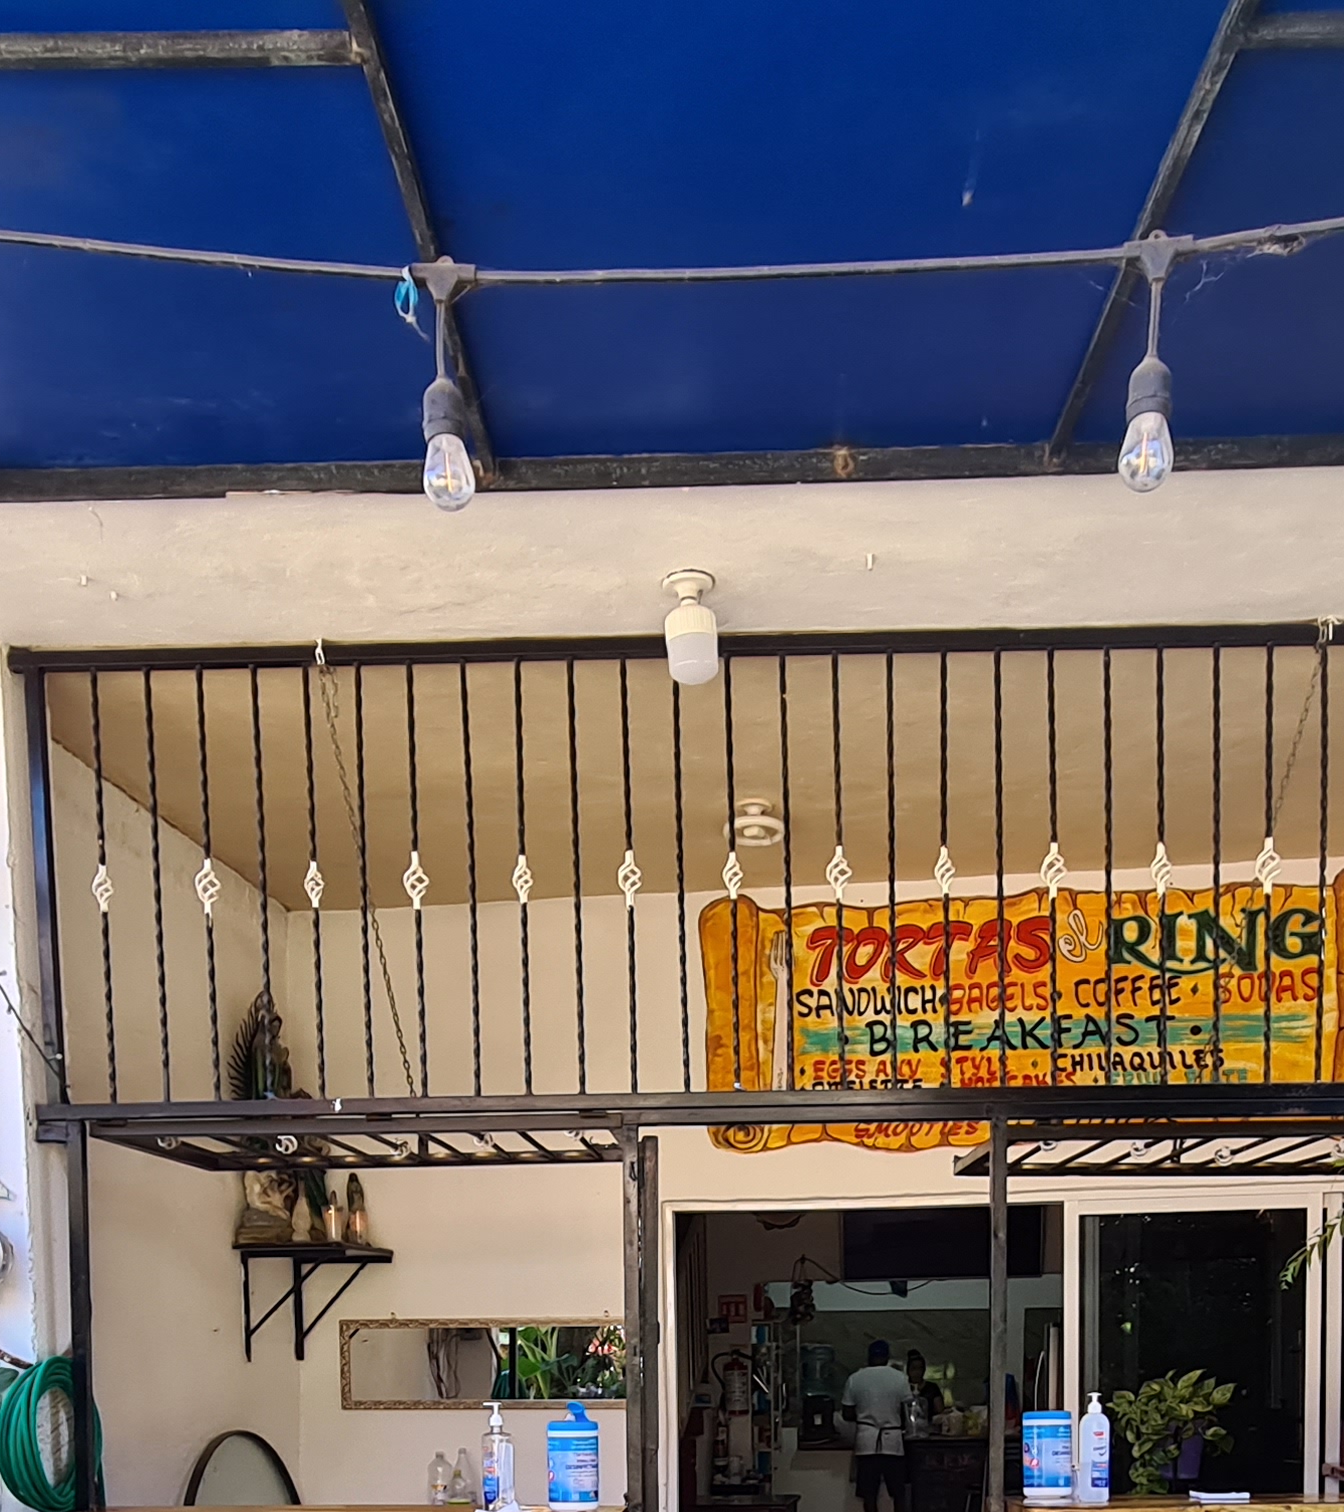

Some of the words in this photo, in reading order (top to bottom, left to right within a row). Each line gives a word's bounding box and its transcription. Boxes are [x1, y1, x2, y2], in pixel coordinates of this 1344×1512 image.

[806, 915, 1052, 987] TORTAS
[1110, 908, 1322, 975] RING
[795, 983, 939, 1018] SANDWICH
[950, 981, 1050, 1014] BAGELS
[1074, 974, 1182, 1008] COFFEE
[1218, 967, 1318, 1004] SODAS
[865, 1012, 1176, 1057] BREAKFAST
[812, 1059, 866, 1080] EGGS
[939, 1055, 1009, 1079] STYL
[1056, 1049, 1225, 1072] CHILAQUILES
